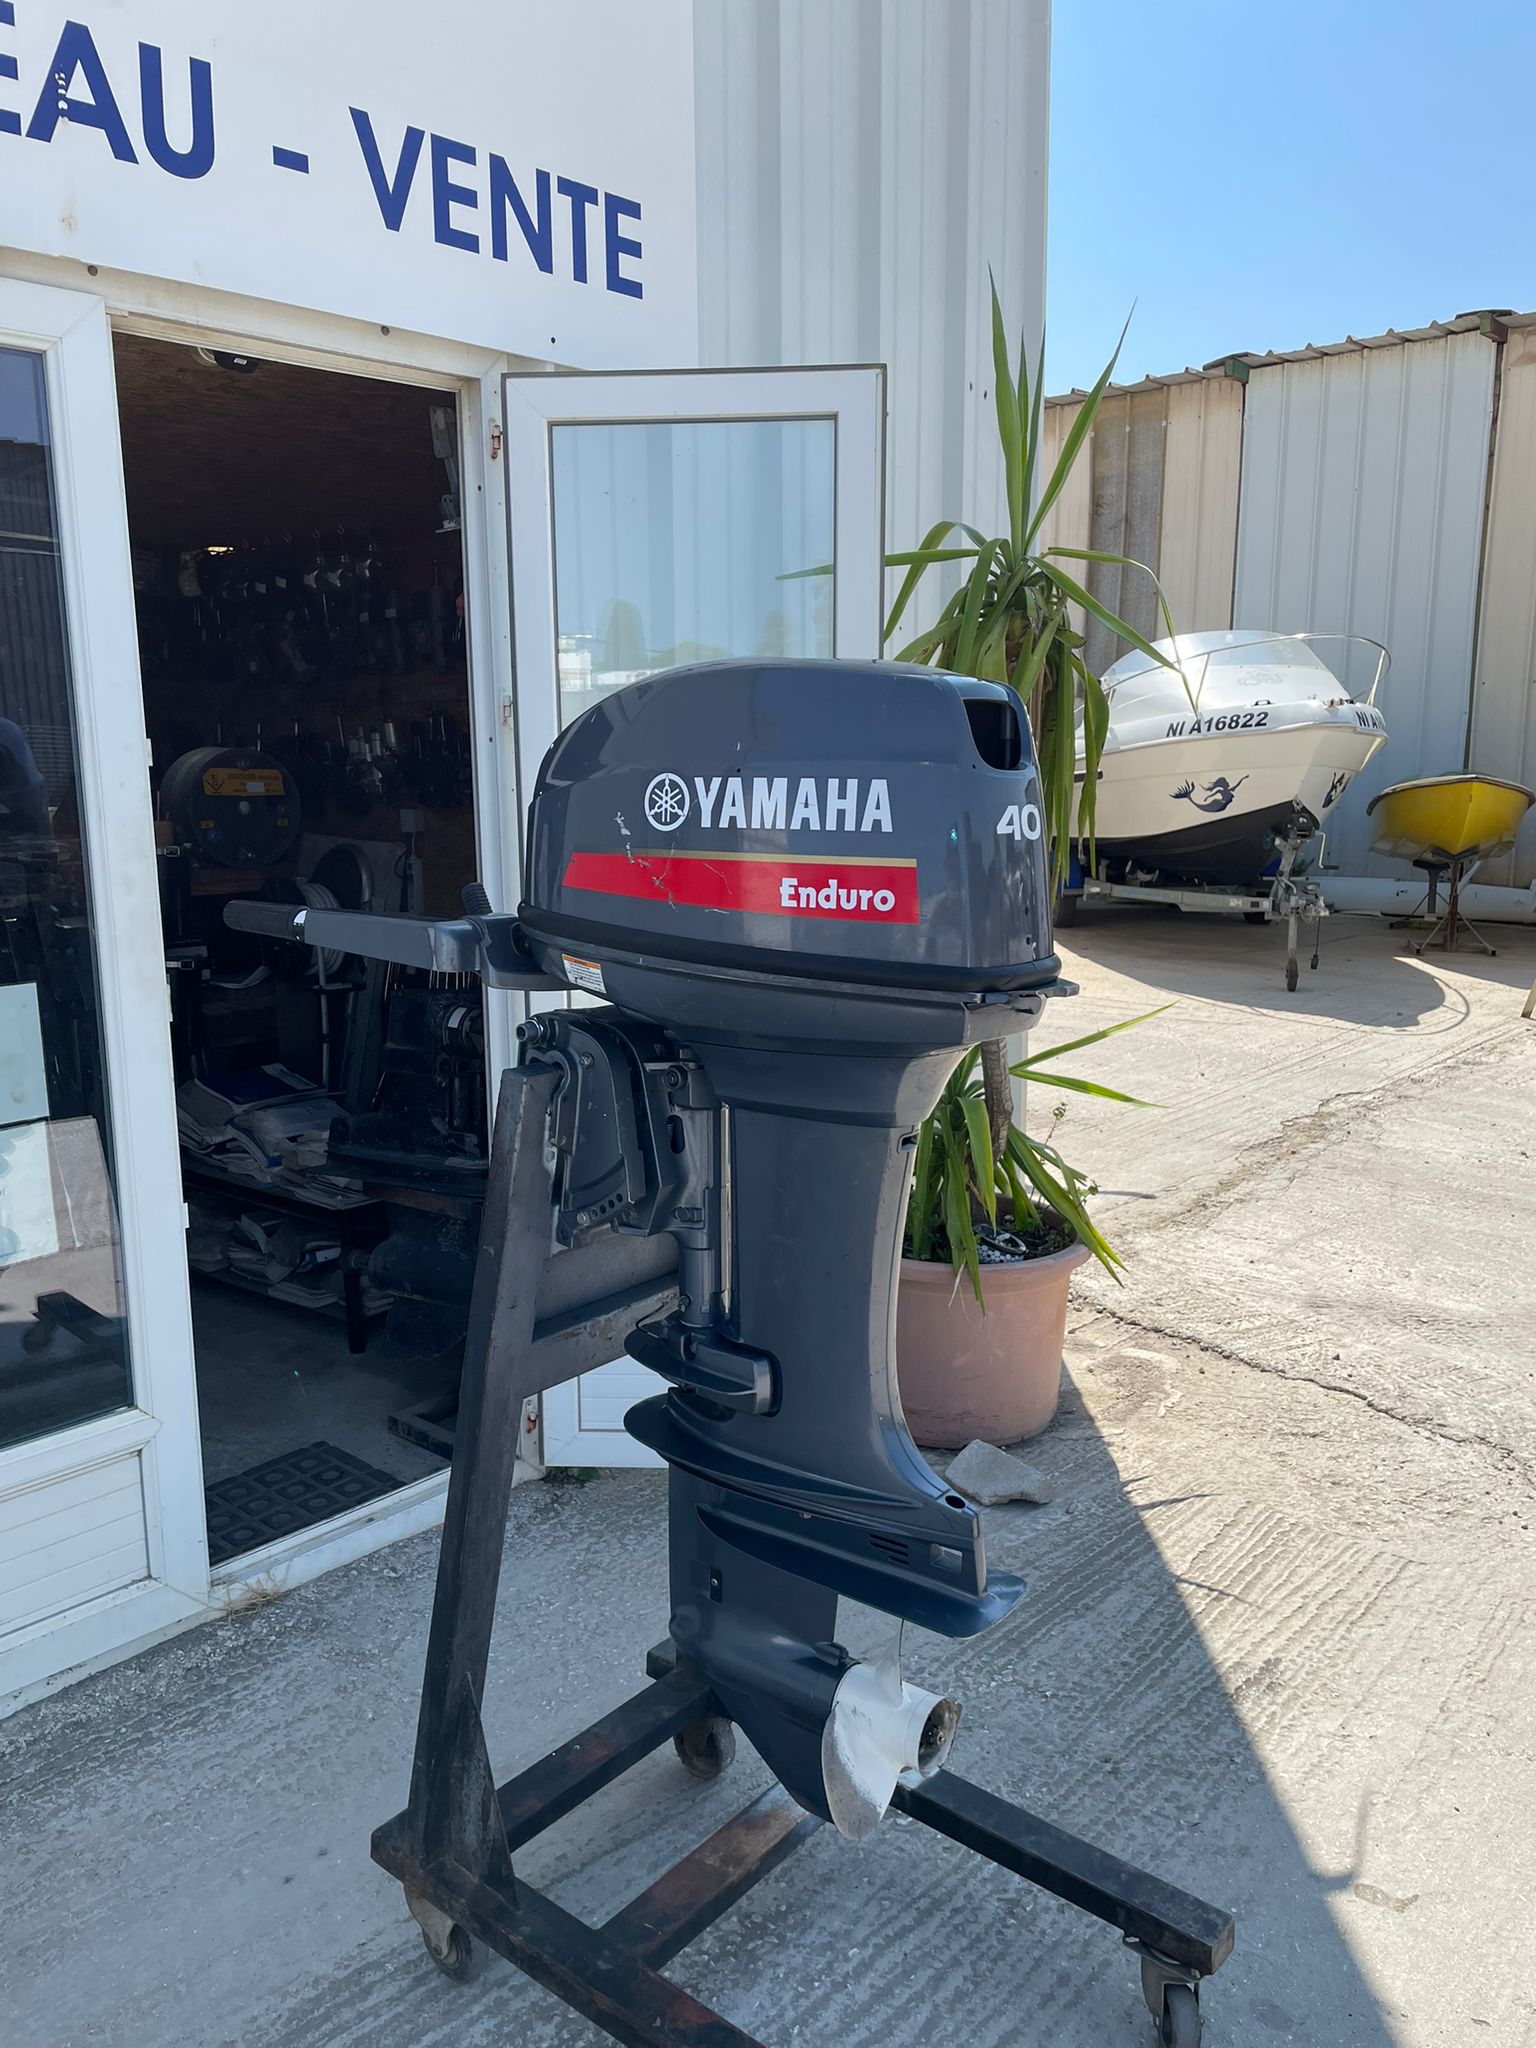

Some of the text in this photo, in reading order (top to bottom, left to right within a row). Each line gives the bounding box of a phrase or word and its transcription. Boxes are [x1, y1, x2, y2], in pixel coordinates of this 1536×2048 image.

[348, 106, 643, 299] VENTE
[1166, 711, 1268, 738] NI A16822
[694, 777, 893, 833] YAMAHA
[996, 804, 1041, 840] 40
[780, 877, 895, 911] Enduro
